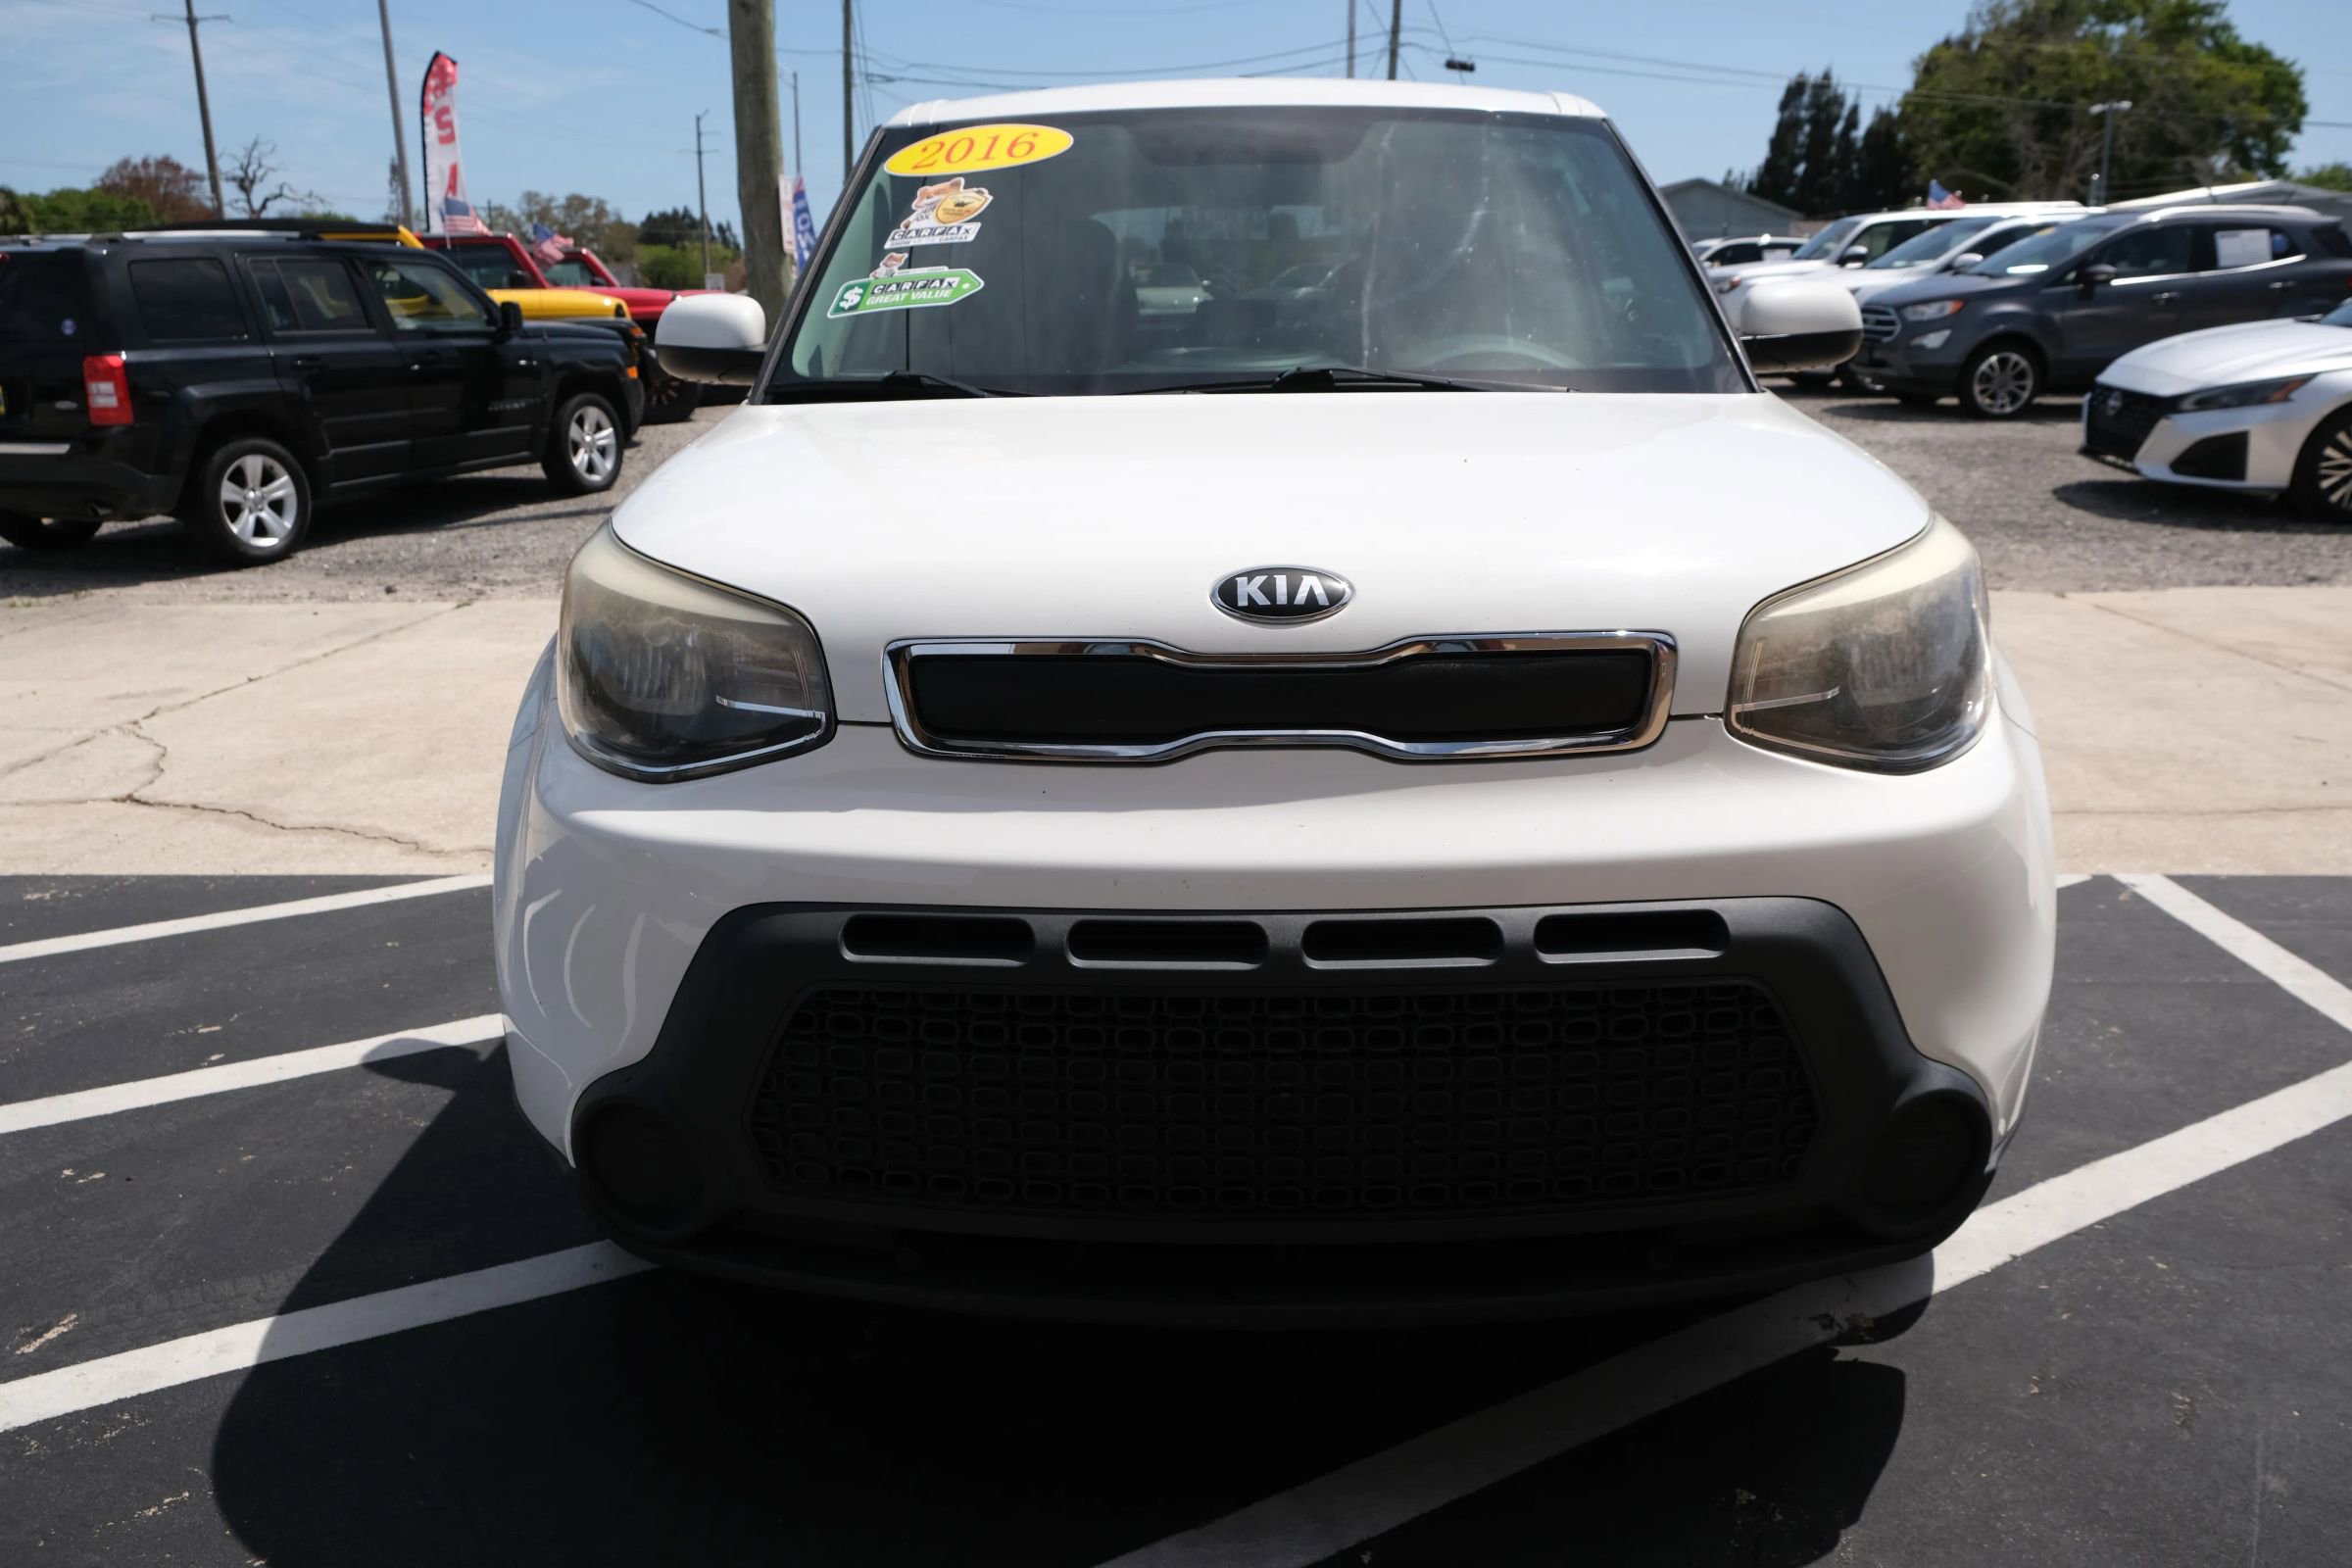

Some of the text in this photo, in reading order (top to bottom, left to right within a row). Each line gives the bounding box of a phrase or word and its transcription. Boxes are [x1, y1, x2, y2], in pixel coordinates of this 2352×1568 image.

[911, 131, 1040, 170] 2016
[892, 225, 972, 241] CARFAX
[872, 276, 960, 295] CARFAX
[866, 288, 954, 306] GREAT VALUE
[1235, 574, 1330, 607] KIA
